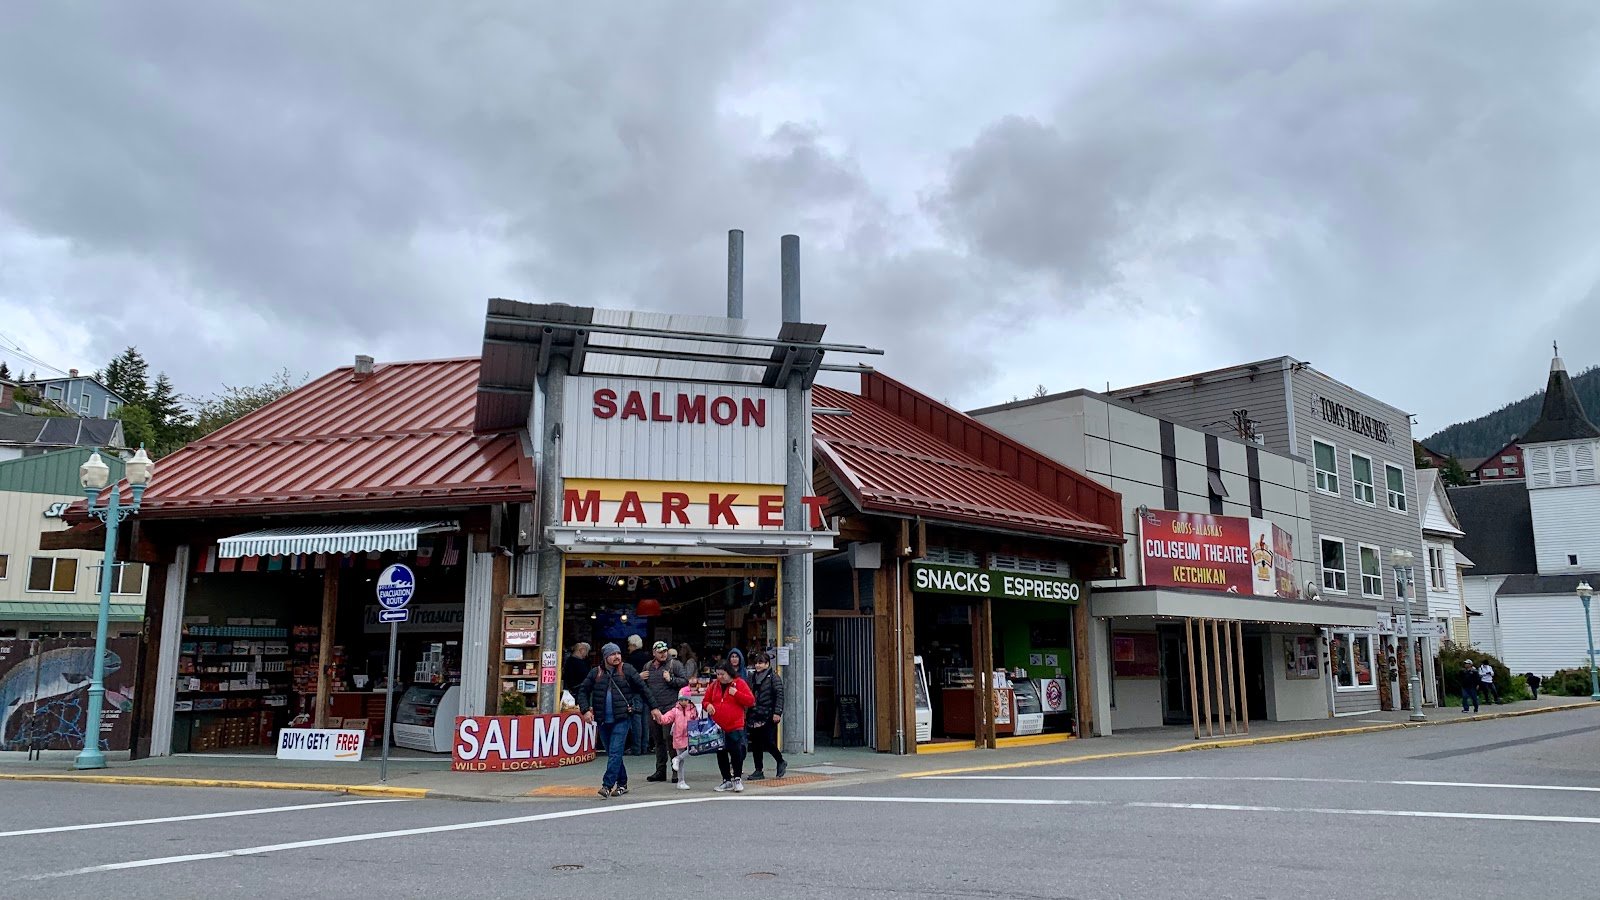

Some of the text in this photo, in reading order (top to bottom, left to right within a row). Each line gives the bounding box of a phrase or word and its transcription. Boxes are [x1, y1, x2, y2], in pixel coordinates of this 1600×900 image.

[592, 388, 766, 428] SALMON
[1345, 407, 1388, 445] TREASURES
[563, 489, 829, 528] MARKET
[1146, 539, 1249, 564] COLISEUM THEATRE
[916, 568, 1080, 601] SNACKS ESPRESSO
[1173, 565, 1226, 584] KETCHIKAN
[379, 589, 411, 598] EVACUATION
[386, 597, 403, 605] ROUTE
[457, 714, 597, 760] SALMON
[455, 762, 487, 771] WILD
[502, 760, 546, 770] LOCAL
